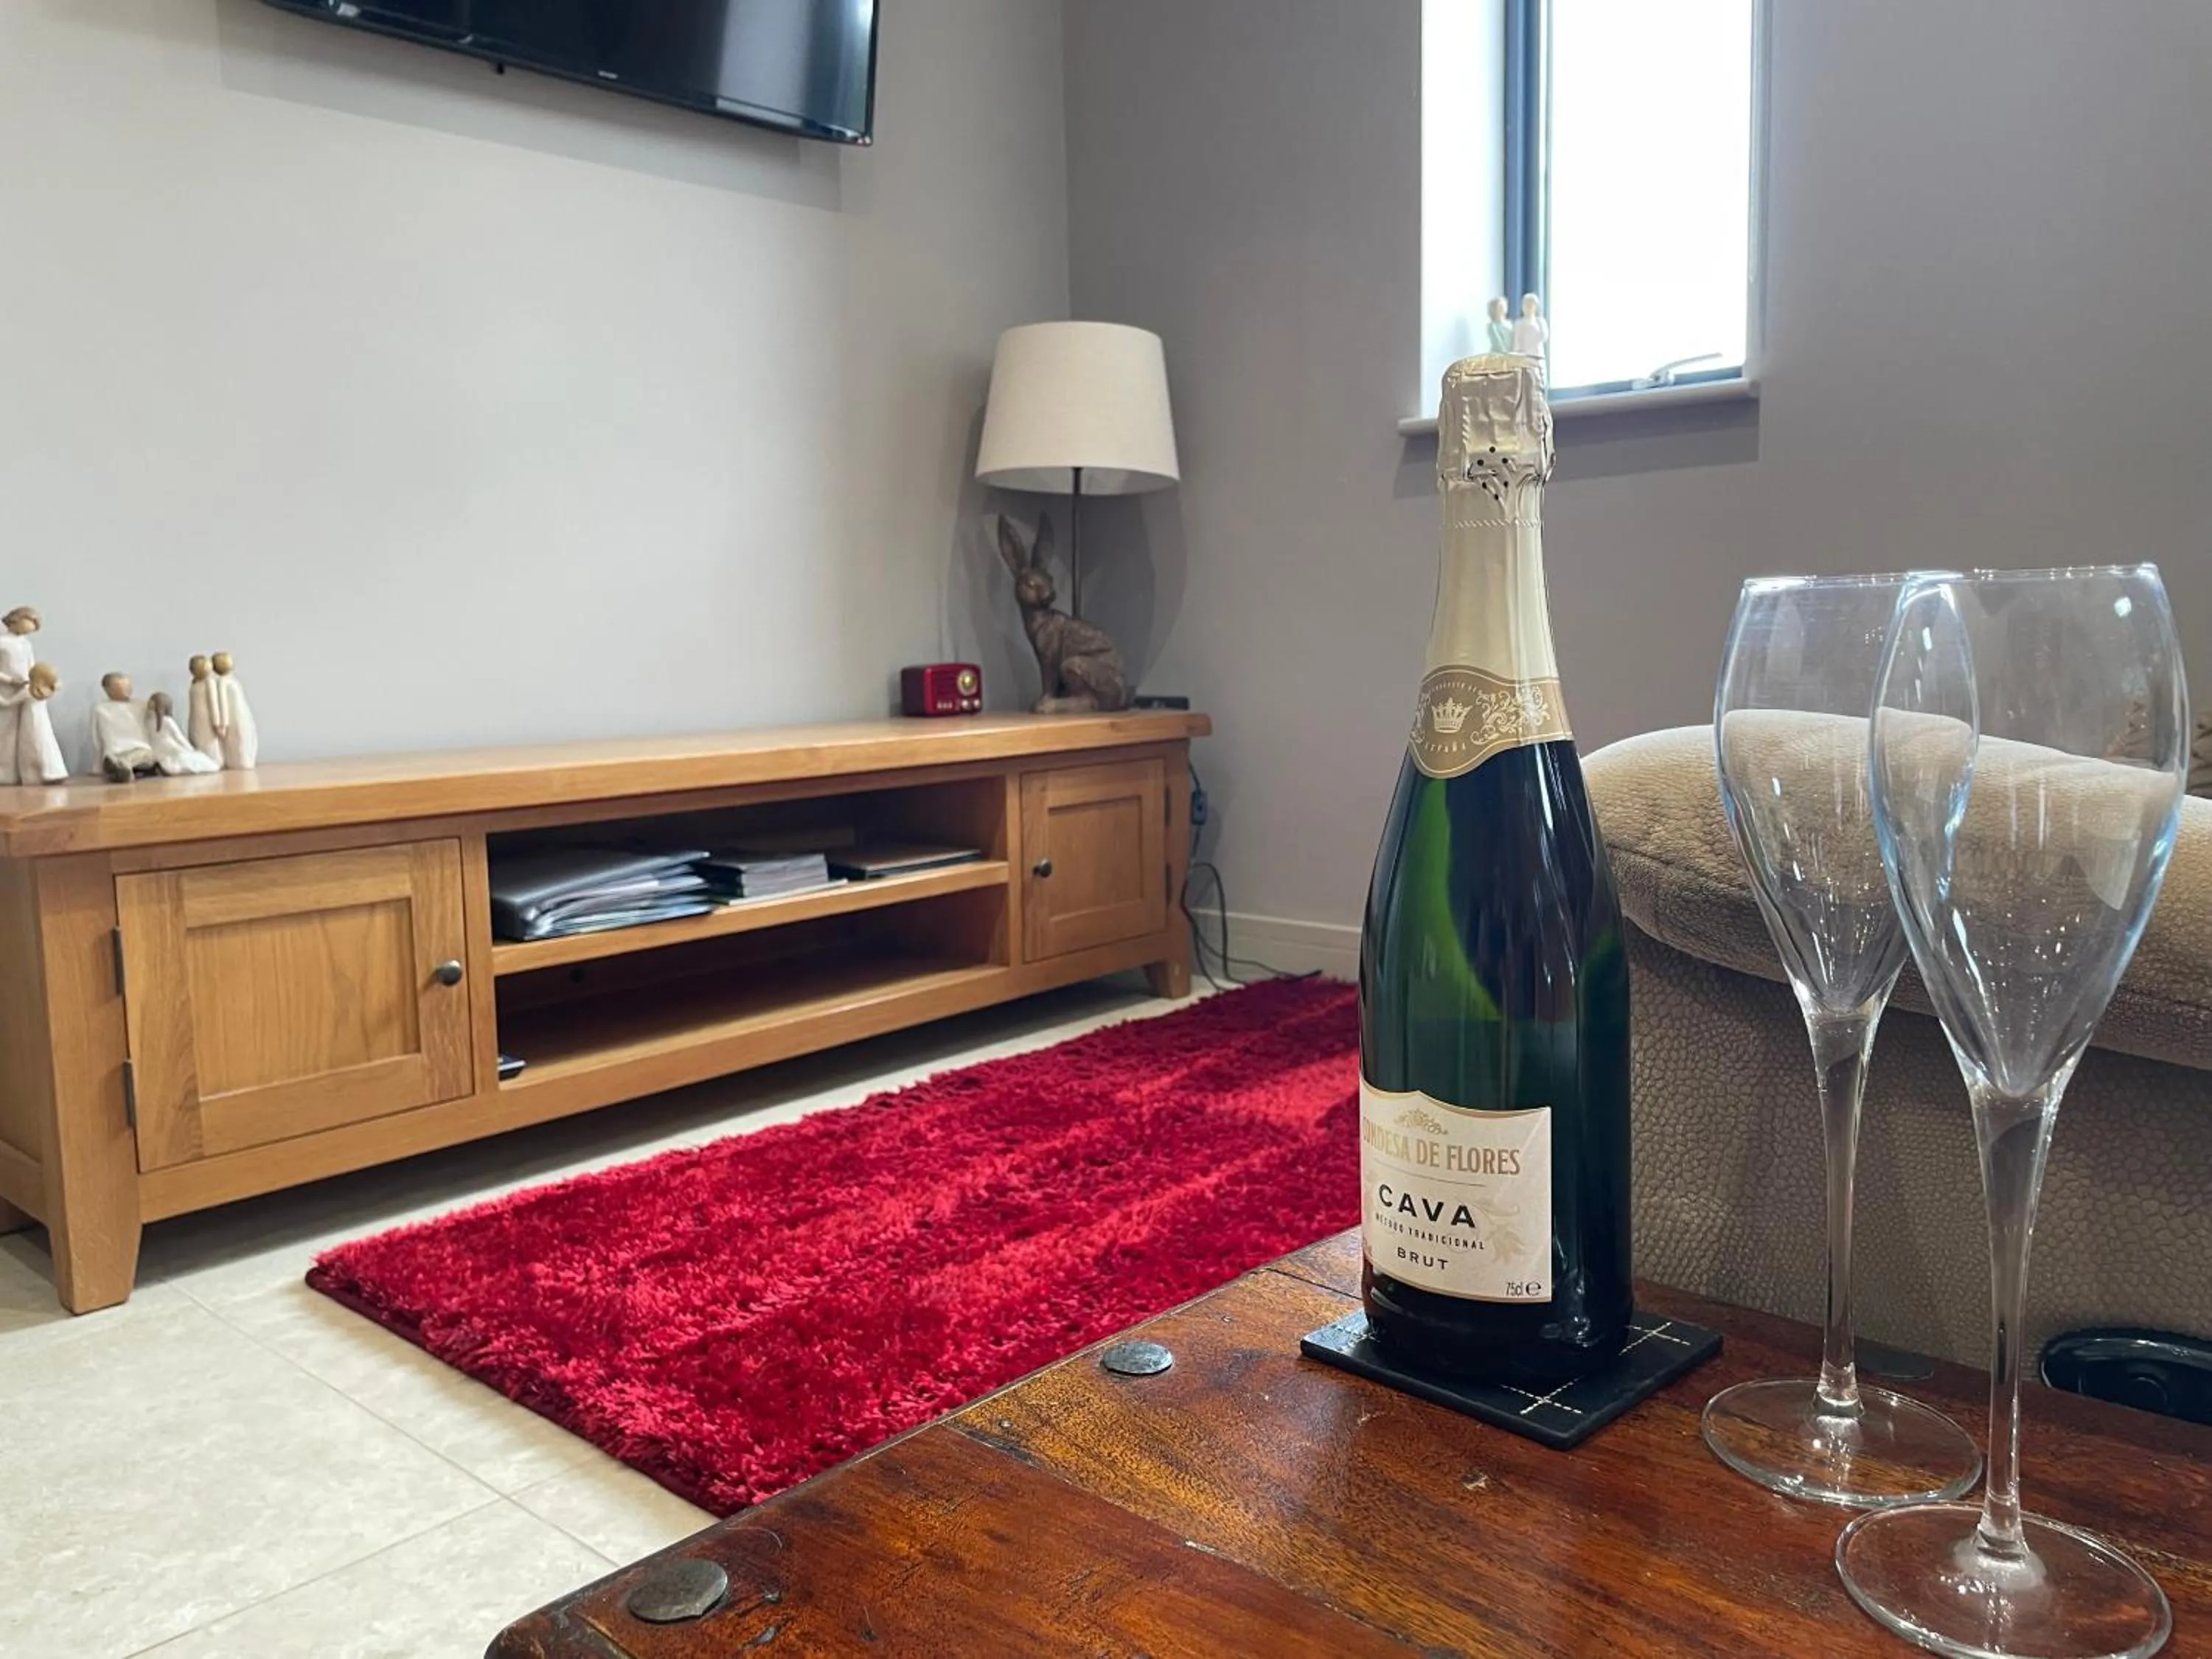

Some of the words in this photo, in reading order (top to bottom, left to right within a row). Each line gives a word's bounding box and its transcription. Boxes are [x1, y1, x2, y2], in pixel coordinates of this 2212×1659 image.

[1416, 1139, 1440, 1167] DE
[1446, 1144, 1521, 1175] FLORES
[1379, 1183, 1476, 1229] CAVA
[1408, 1226, 1485, 1251] TRADICIONAL
[1397, 1247, 1449, 1270] BRUT
